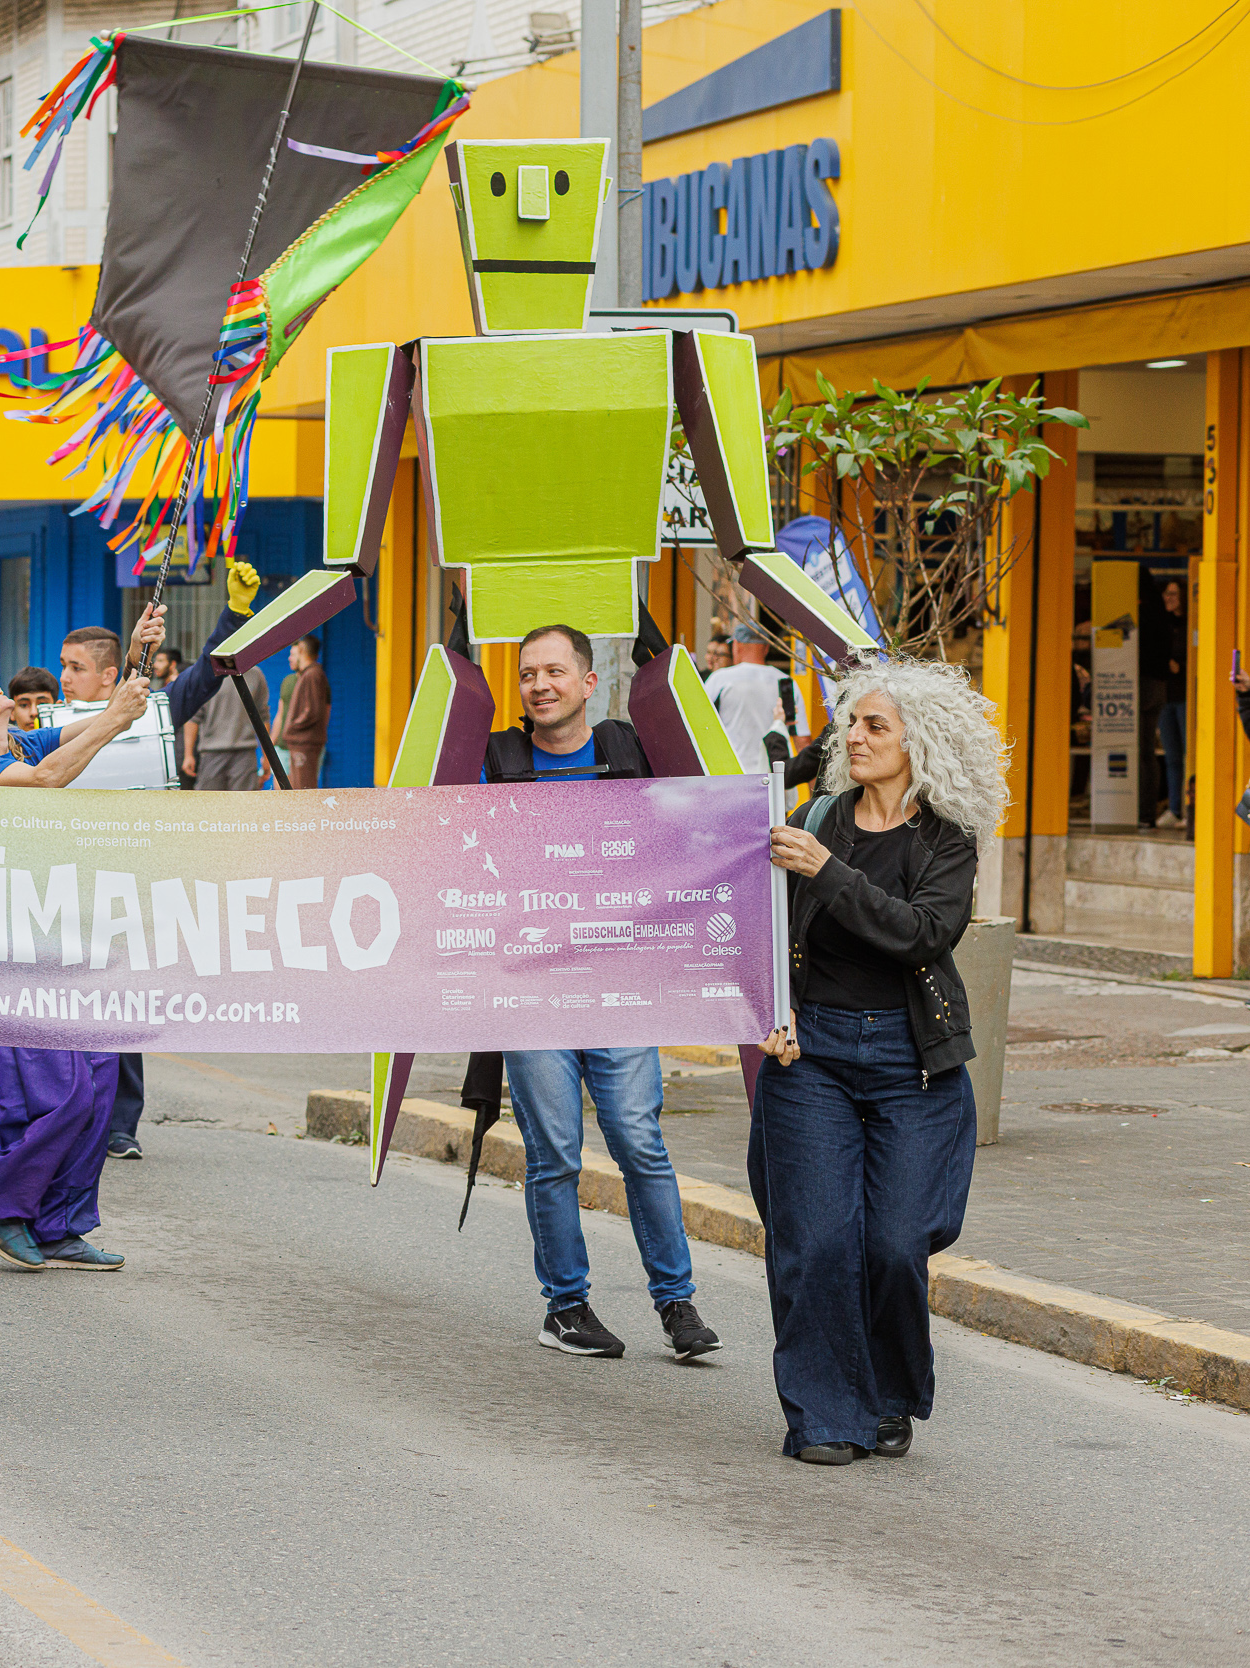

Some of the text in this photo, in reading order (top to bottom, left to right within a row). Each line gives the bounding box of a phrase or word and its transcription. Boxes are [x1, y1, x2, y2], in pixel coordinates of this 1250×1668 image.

[1098, 703, 1134, 717] 10%
[12, 816, 67, 830] Cultura,
[71, 818, 130, 831] Governo
[134, 819, 150, 832] de
[154, 820, 194, 832] Santa
[199, 819, 258, 832] Catarina
[262, 822, 271, 832] e
[275, 818, 317, 832] Essaé
[321, 817, 397, 834] Produções
[76, 836, 151, 849] apresentam
[545, 843, 586, 858] PNAB
[445, 888, 508, 907] Bistek
[518, 888, 586, 912] TIROL
[595, 892, 632, 905] ICRH
[666, 889, 712, 903] TIGRE
[572, 923, 695, 939] SIEDSCHLAG EMBALAGENS
[436, 928, 496, 949] URBANO
[702, 944, 742, 956] Celesc
[701, 985, 744, 998] BRASIL
[493, 996, 519, 1009] PIC
